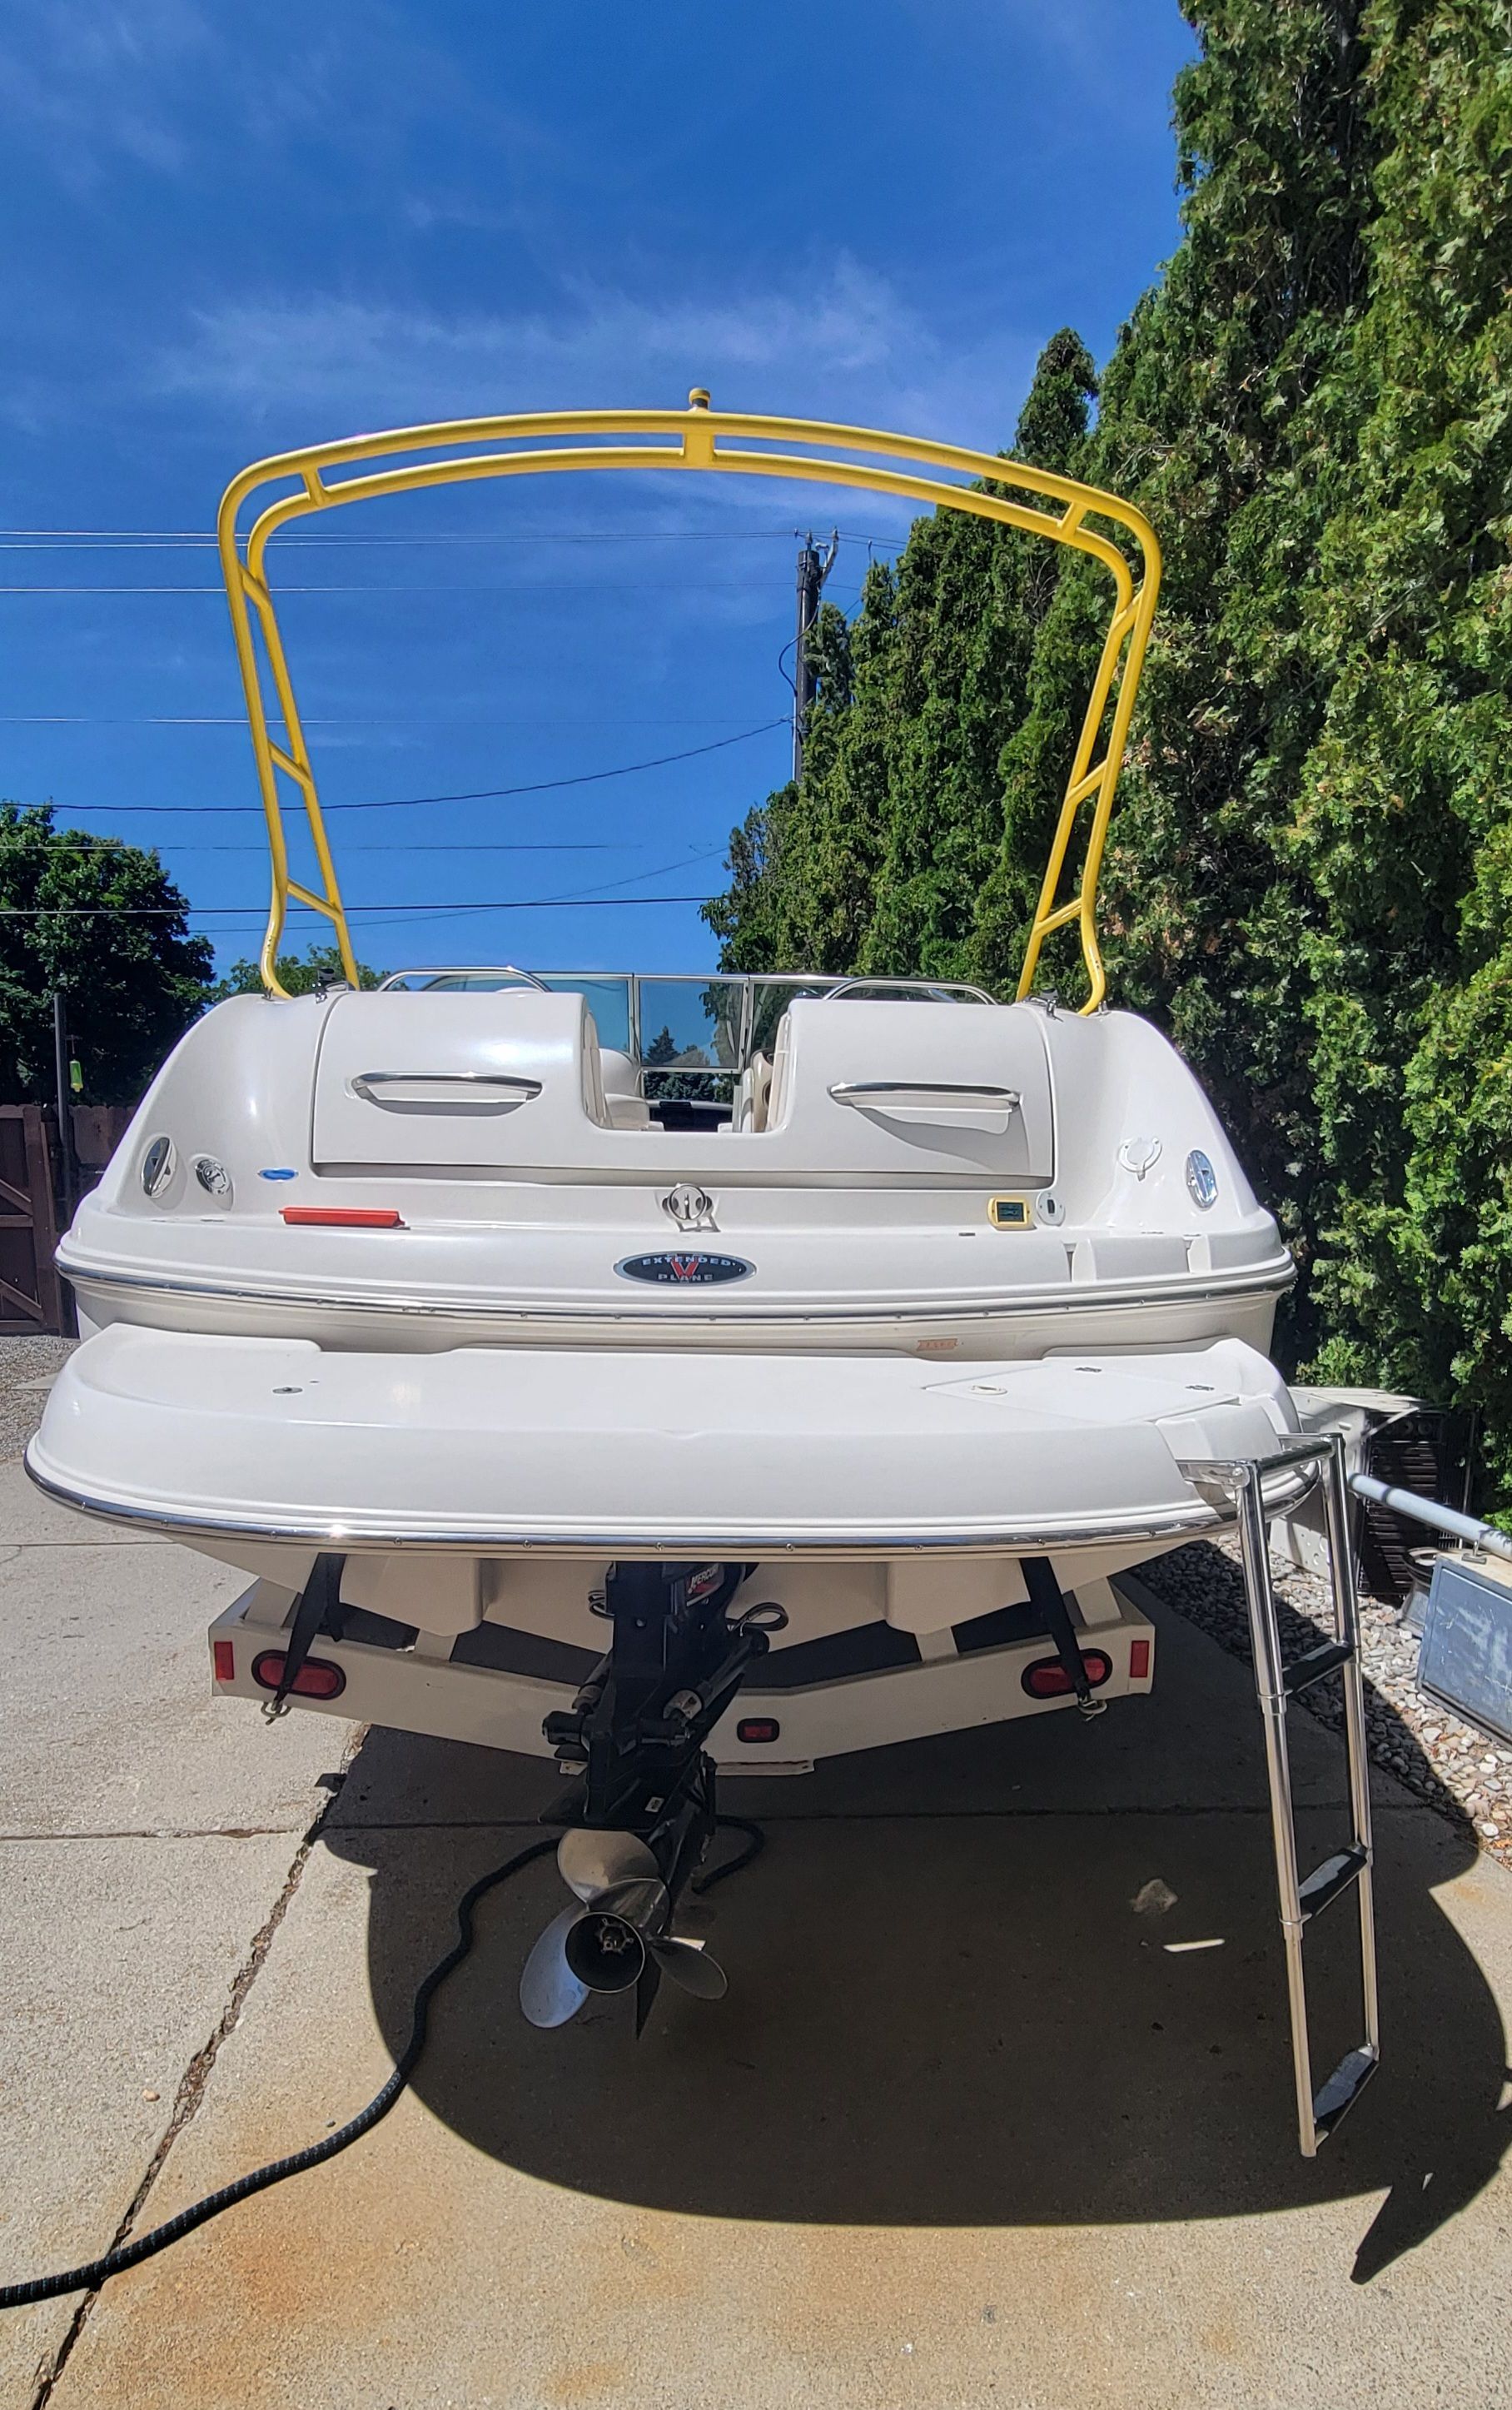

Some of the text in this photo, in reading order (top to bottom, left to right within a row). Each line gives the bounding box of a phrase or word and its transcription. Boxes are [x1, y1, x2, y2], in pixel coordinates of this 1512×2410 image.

[642, 1256, 731, 1267] EXTENDED
[668, 1253, 701, 1282] V
[658, 1273, 714, 1282] PLANE
